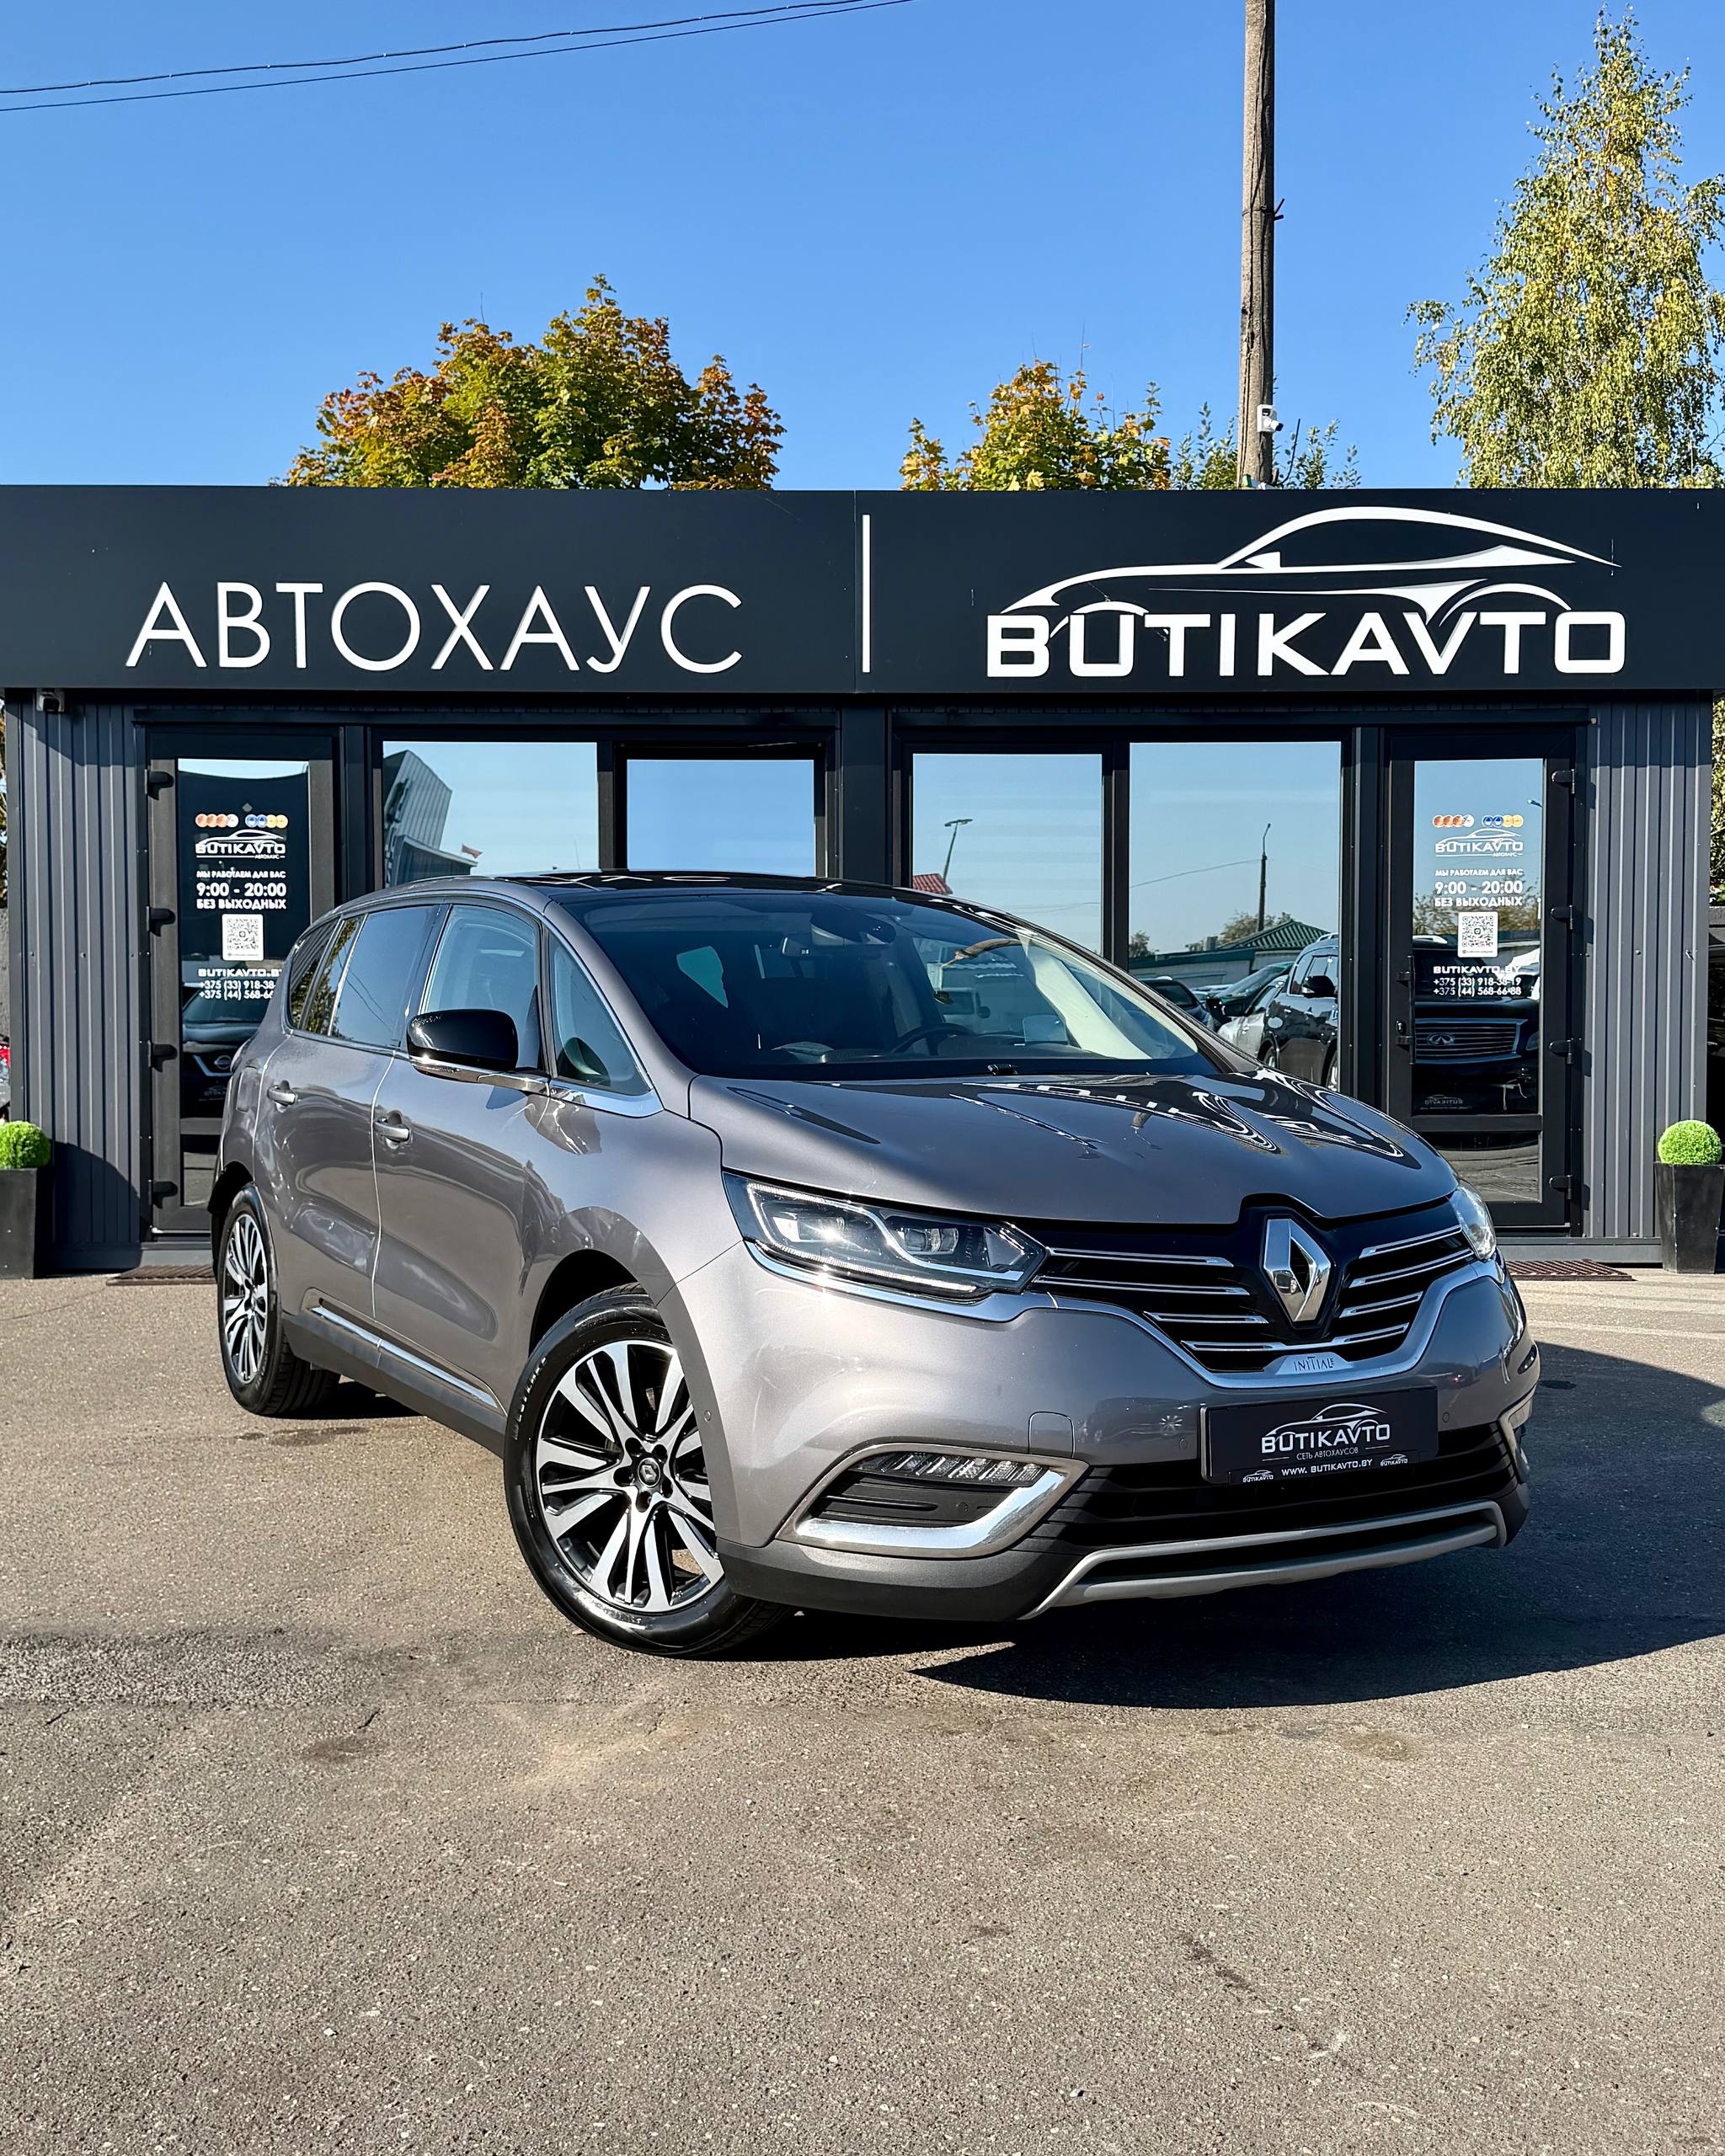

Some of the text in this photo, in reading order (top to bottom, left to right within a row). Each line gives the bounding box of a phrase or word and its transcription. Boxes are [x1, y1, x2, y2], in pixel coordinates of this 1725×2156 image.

[126, 581, 743, 674] АВТОХАУС
[986, 611, 1626, 679] BUTIKAVTO
[195, 843, 286, 854] BUTIKAVTO
[1434, 842, 1524, 853] BUTIKAVTO
[1490, 868, 1506, 877] ДЛЯ
[196, 882, 229, 897] 9:00
[244, 882, 286, 897] 20:00
[1434, 881, 1466, 894] 9:00
[1482, 880, 1524, 894] 20:00
[196, 899, 286, 910] БЕЗ ВЫХОДНЫХ
[1434, 896, 1523, 907] БЕЗ ВЫХОДНЫХ
[198, 969, 282, 977] BUTIKAVTO.B
[1433, 965, 1521, 974] BUTIKAVTO.BY
[199, 979, 275, 990] +375 (33) 918-38-
[1433, 978, 1455, 986] +375
[1458, 977, 1475, 987] (33)
[199, 990, 222, 999] +375
[223, 990, 242, 1001] (44)
[1433, 986, 1521, 997] +375 (44) 568-66-88
[1293, 1356, 1334, 1371] INITIALE
[1262, 1424, 1390, 1454] BUTIKAVTO
[1296, 1447, 1359, 1460] СЕТЬ АВТОХАУСОВ
[1281, 1459, 1373, 1476] WWW. BUTIKAVTO.BY
[1381, 1458, 1408, 1467] BUTIKAVTO
[1242, 1475, 1274, 1483] BUTIKAVTO
